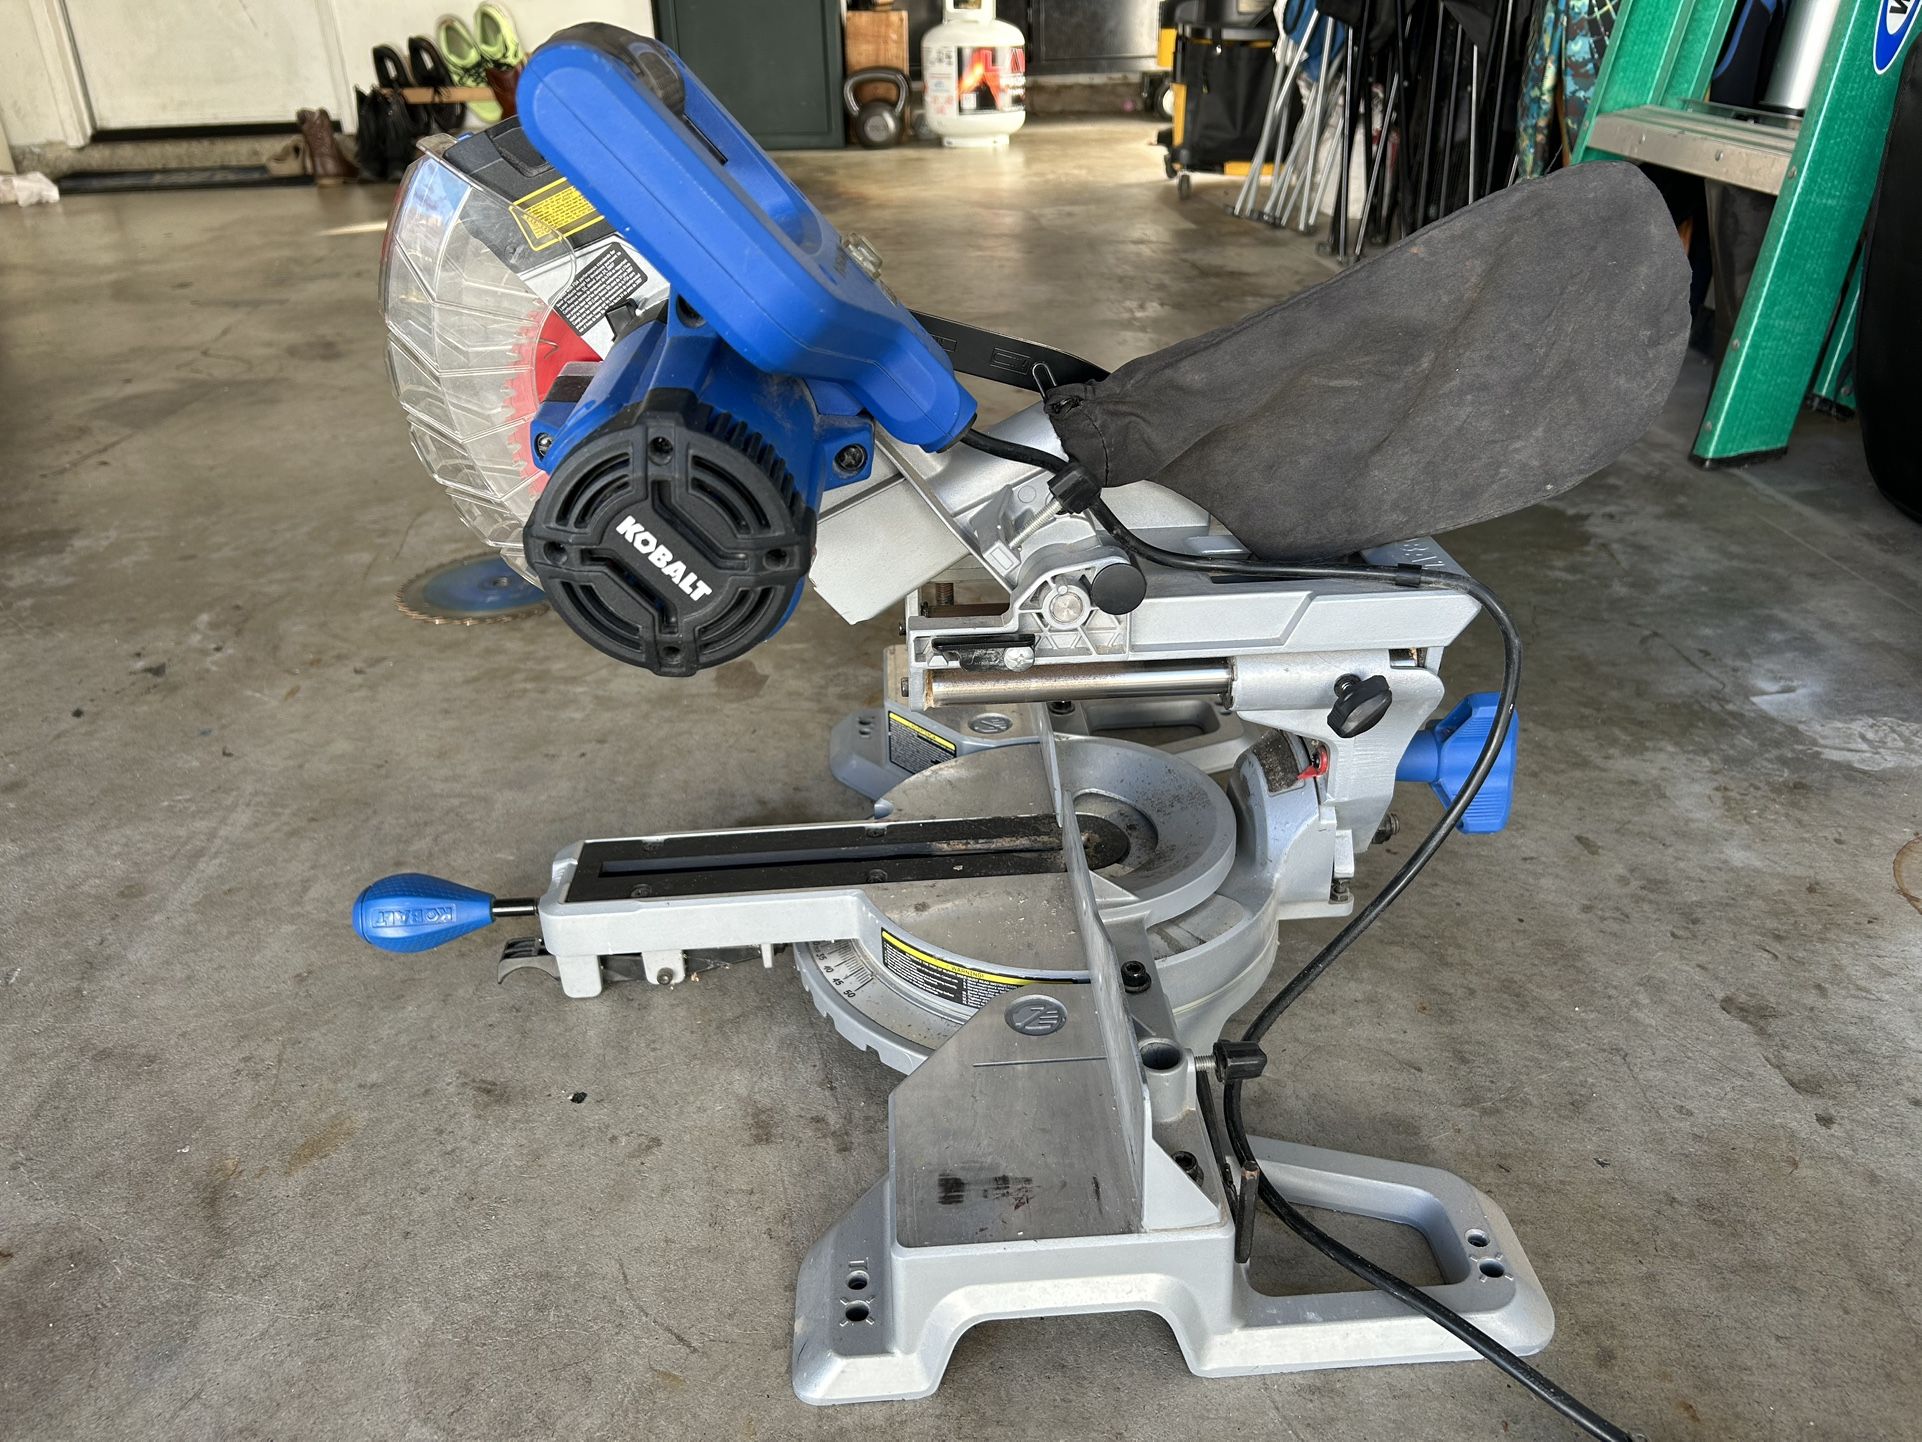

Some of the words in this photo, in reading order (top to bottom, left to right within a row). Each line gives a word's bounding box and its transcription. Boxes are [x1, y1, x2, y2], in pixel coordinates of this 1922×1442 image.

[616, 515, 712, 601] KOBALT
[375, 906, 453, 925] KOBALT
[814, 953, 828, 961] 35
[833, 978, 845, 986] 45
[843, 989, 856, 998] 50
